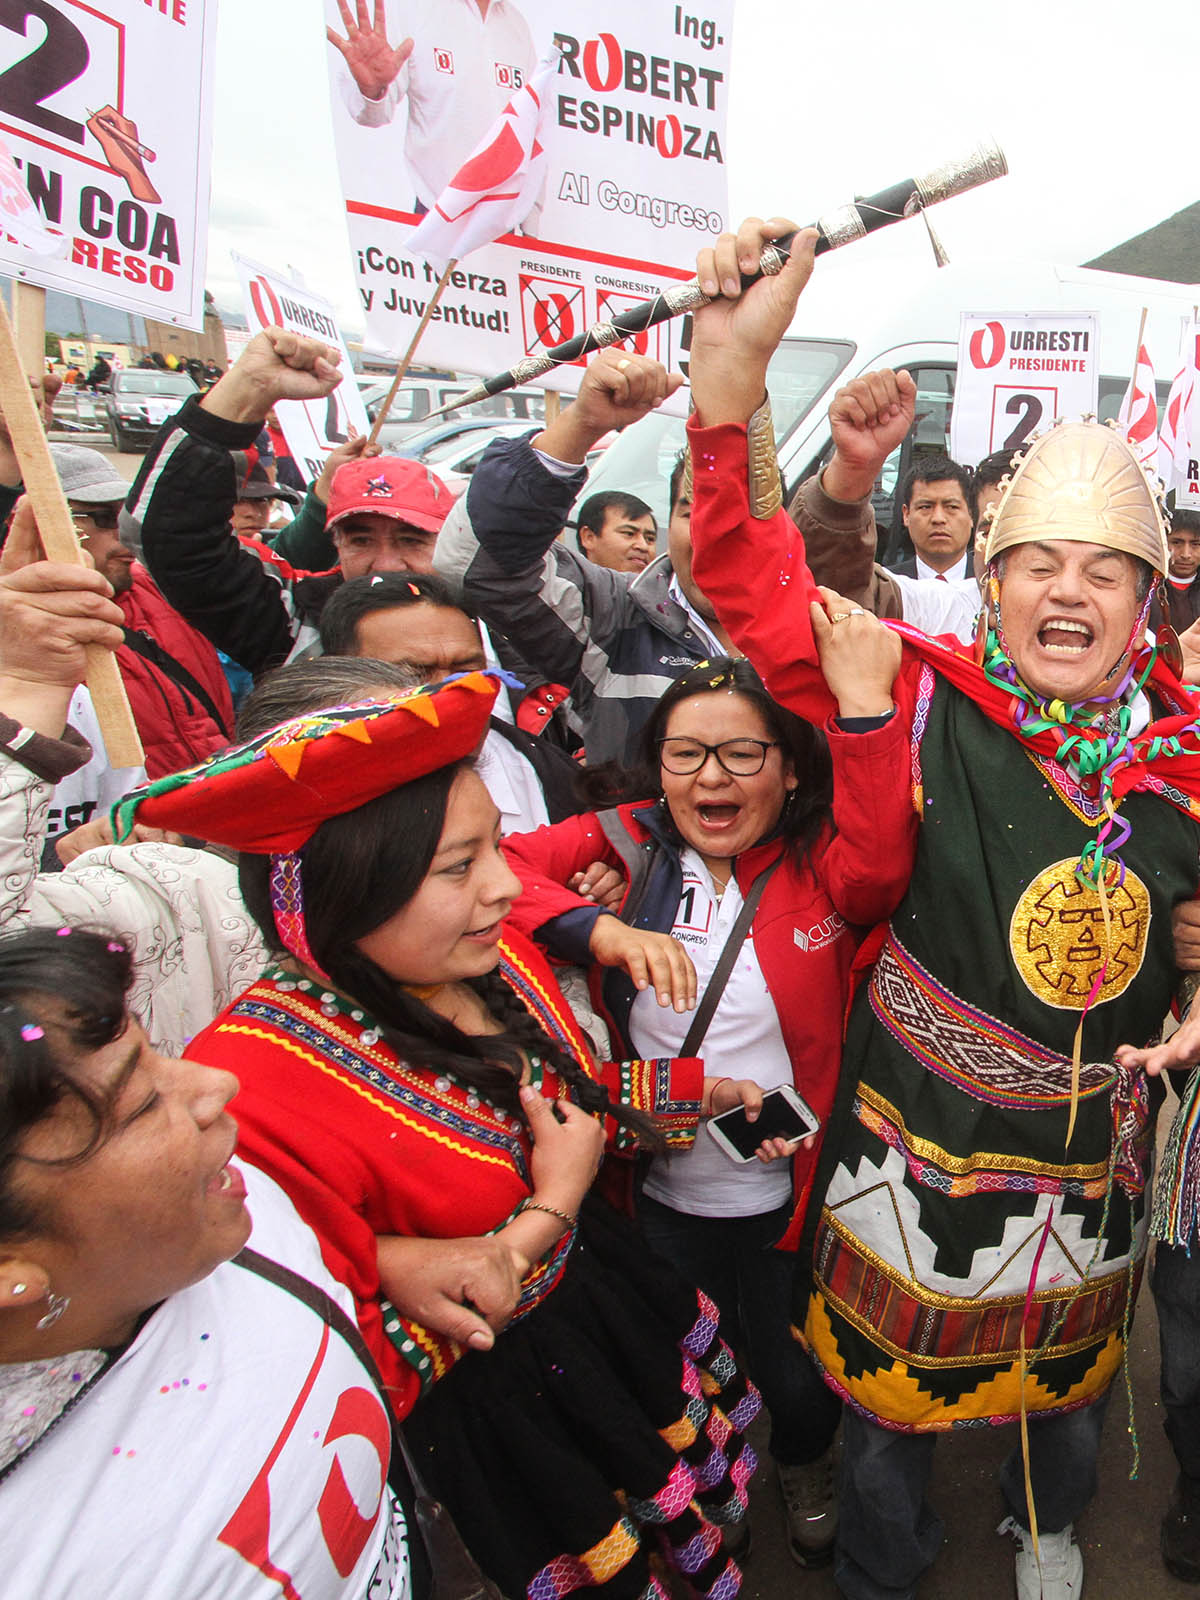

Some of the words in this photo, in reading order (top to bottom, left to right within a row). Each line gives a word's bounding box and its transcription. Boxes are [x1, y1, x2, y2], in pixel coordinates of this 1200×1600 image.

[675, 5, 724, 51] Ing.
[553, 32, 724, 111] ROBERT
[558, 94, 724, 164] ESPINOZA
[79, 185, 181, 266] COA
[558, 171, 590, 206] Al
[597, 180, 723, 235] Congreso
[520, 260, 582, 281] PRESIDENTE
[594, 274, 661, 295] CONGRESISTA
[280, 296, 339, 341] URRESTI
[360, 288, 374, 312] y
[384, 288, 510, 334] Juventud!
[1009, 330, 1090, 352] URRESTI
[1009, 357, 1086, 373] PRESIDENTE
[1003, 393, 1043, 450] 2
[671, 931, 708, 946] CONGRESO
[808, 912, 845, 942] CUTC
